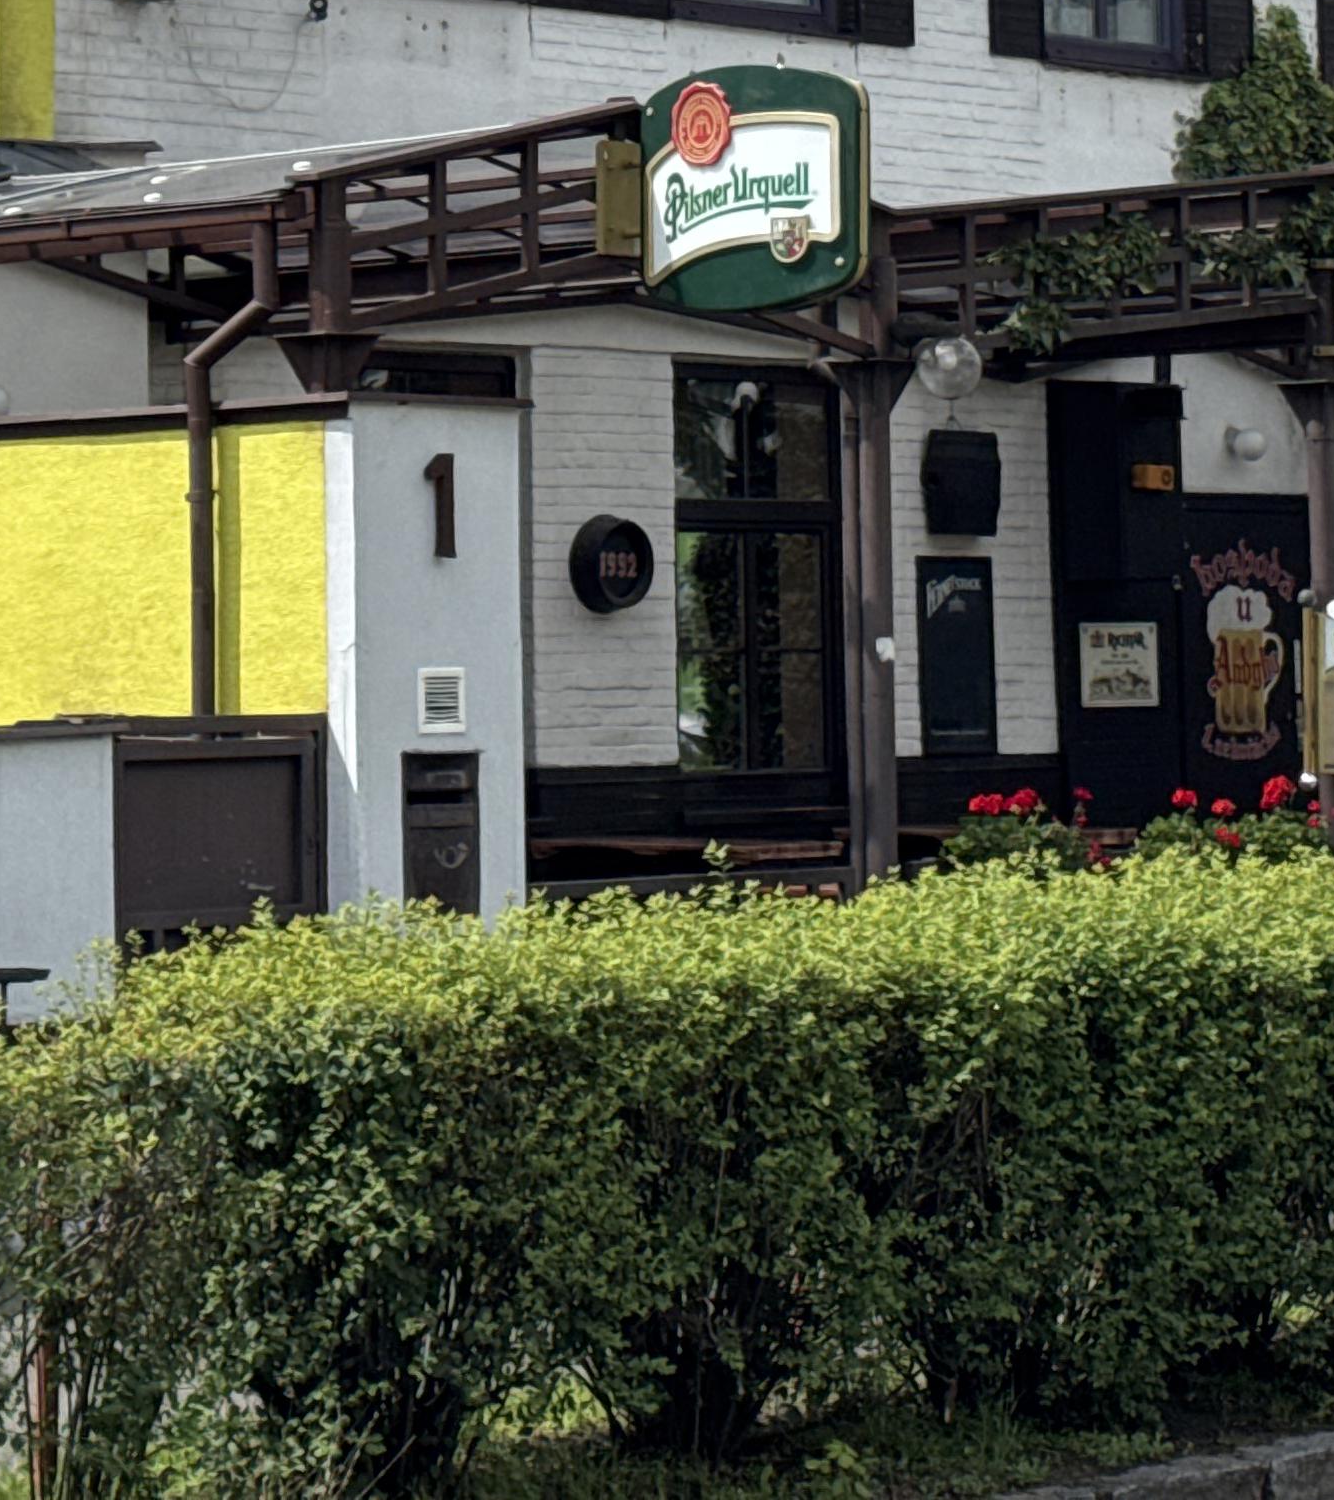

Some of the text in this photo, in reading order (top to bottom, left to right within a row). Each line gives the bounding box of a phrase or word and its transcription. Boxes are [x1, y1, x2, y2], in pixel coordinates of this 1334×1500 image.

[664, 162, 810, 243] Pilsner Urquell
[423, 452, 457, 559] 1
